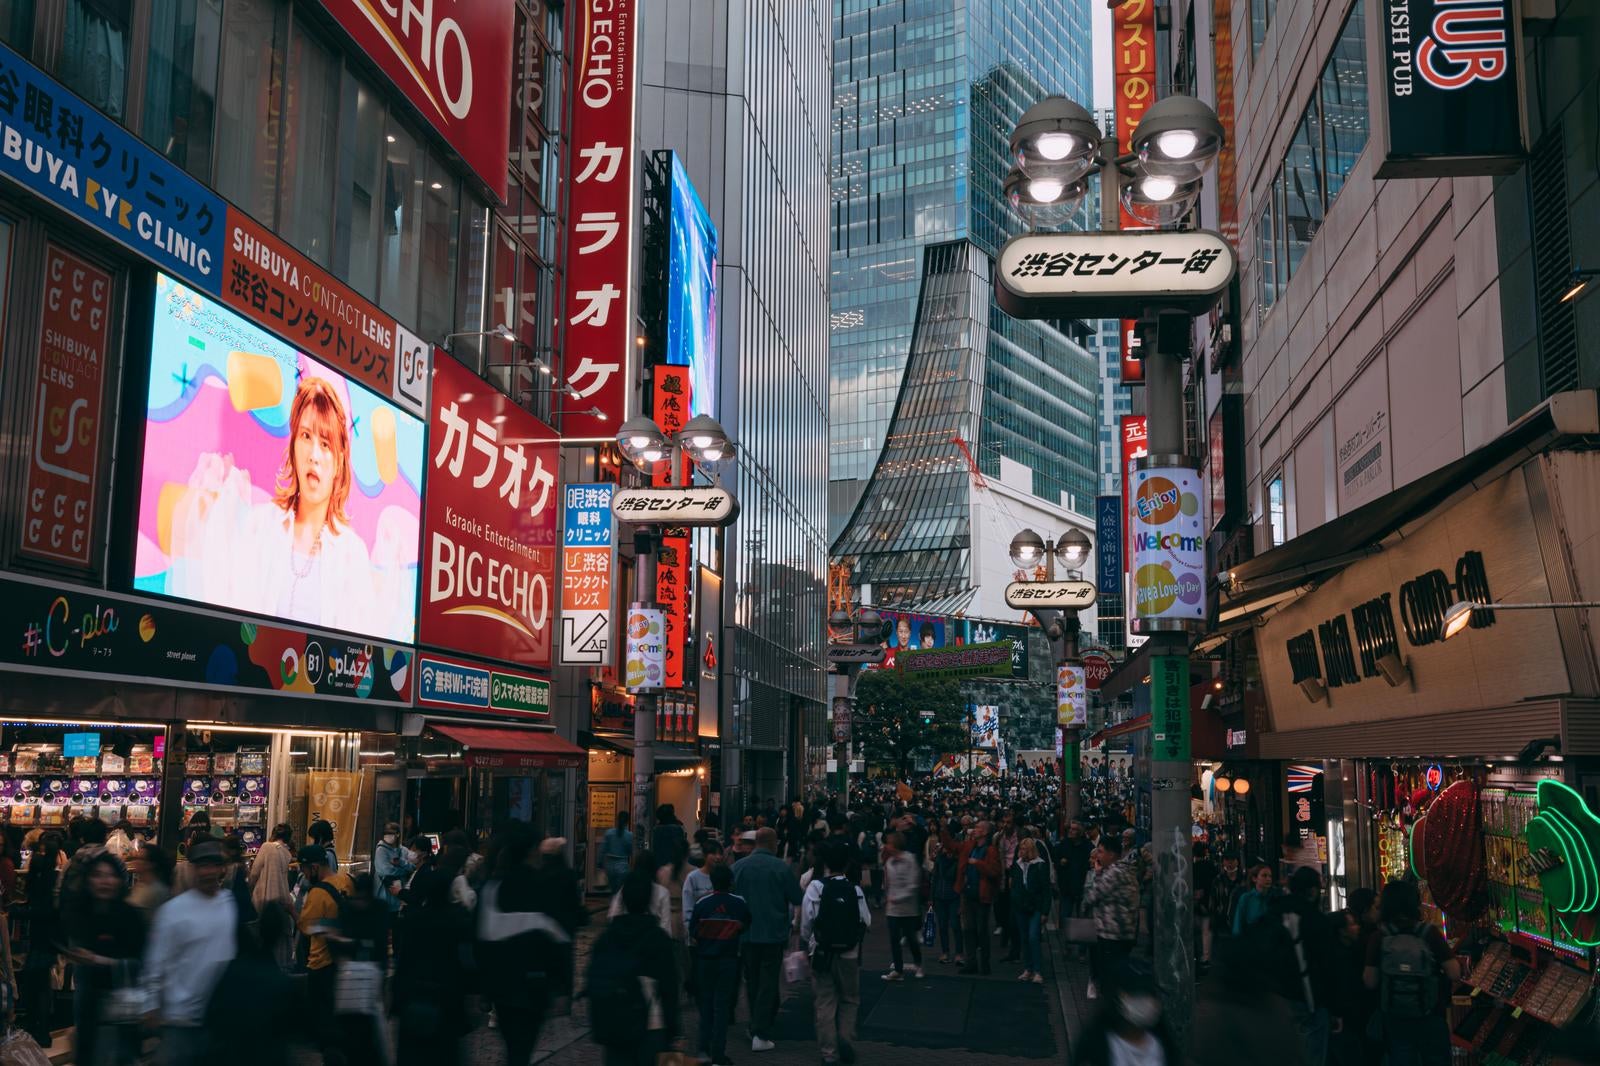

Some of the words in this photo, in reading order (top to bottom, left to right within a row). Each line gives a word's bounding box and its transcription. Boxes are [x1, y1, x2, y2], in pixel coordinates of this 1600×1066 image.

[1390, 0, 1410, 45] ISH
[616, 13, 627, 92] Entertainment
[1416, 0, 1506, 89] UB
[583, 20, 613, 109] ECHO
[1392, 50, 1412, 97] PUB
[0, 120, 79, 198] BUYA
[137, 213, 212, 276] CLINIC
[567, 142, 624, 400] カラオケ
[1011, 249, 1222, 277] 渋谷センター街
[233, 227, 299, 290] SHIBUYA
[302, 275, 361, 329] CONTACT
[362, 314, 391, 349] LENS
[230, 259, 390, 384] 渋谷コンタクトレンズ
[45, 329, 98, 364] SHIBUYA
[43, 364, 74, 390] LENS
[435, 401, 554, 517] カラオケ
[585, 489, 611, 508] 渋谷
[616, 496, 724, 511] 渋谷センター街
[1136, 488, 1178, 518] Enjoy
[577, 511, 601, 525] 眼科
[446, 506, 483, 538] Karaoke
[485, 524, 540, 563] Entertainment
[567, 529, 610, 542] クリニック
[1102, 502, 1116, 589] 大盛堂商事ビル
[1134, 531, 1203, 553] Welcome
[583, 552, 609, 573] 渋谷
[430, 531, 483, 603] BIG
[488, 559, 548, 631] ECHO
[565, 577, 608, 589] コンタクト
[1010, 588, 1091, 600] 渋谷センター街
[1158, 581, 1184, 598] Lovely
[574, 592, 600, 605] レンズ
[166, 650, 181, 660] street
[181, 652, 196, 662] planet
[590, 639, 607, 650] 入口
[627, 644, 662, 653] Welcome
[307, 654, 320, 674] B1
[435, 669, 488, 699] 無料Wi-Fi完備
[501, 682, 549, 706] スマホ充電器完備
[1164, 659, 1182, 757] 客引きは犯罪です
